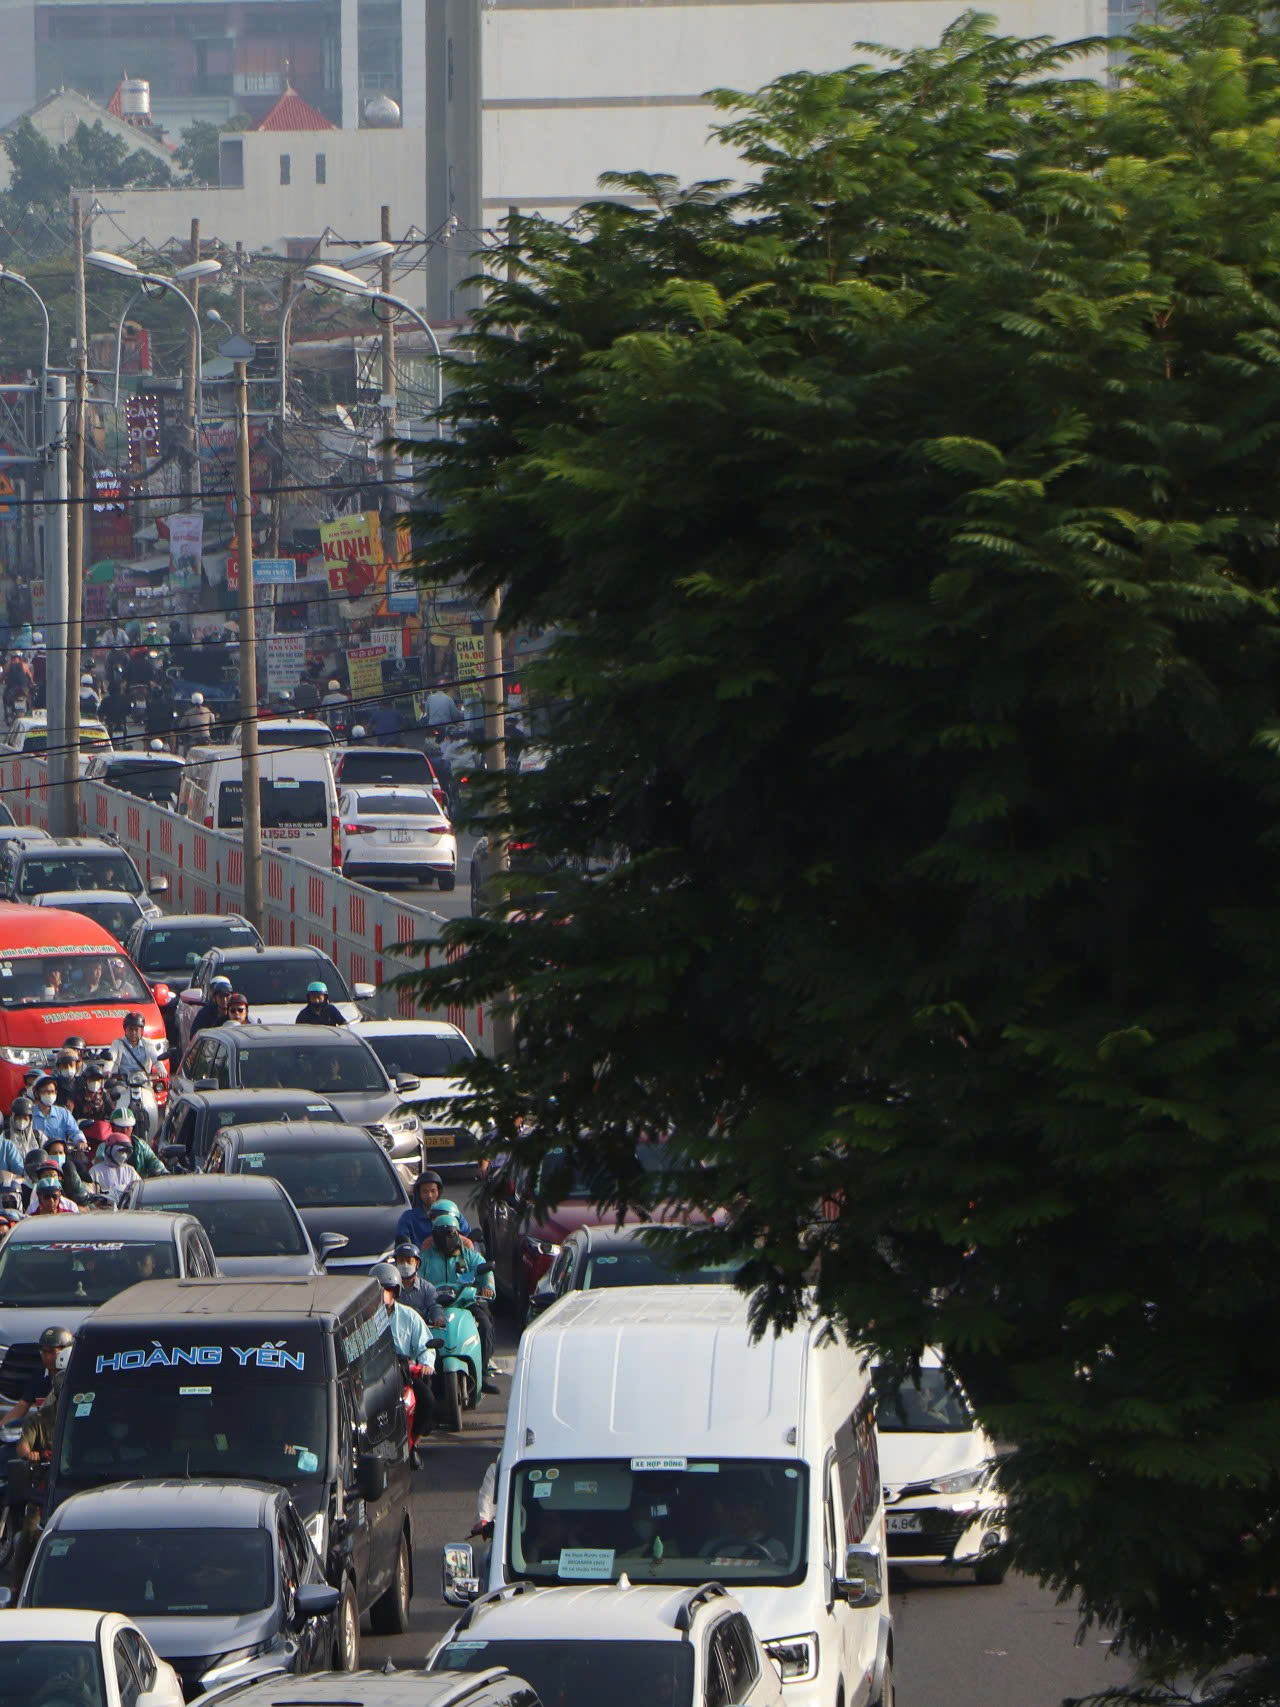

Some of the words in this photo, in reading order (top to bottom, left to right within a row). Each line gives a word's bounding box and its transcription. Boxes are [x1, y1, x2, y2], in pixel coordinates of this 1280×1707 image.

[323, 536, 371, 562] KINH
[42, 1010, 91, 1024] PHƯƠNG
[95, 1340, 222, 1373] HOÀNG
[230, 1340, 305, 1371] YẾN
[663, 1459, 683, 1467] ĐỒNG
